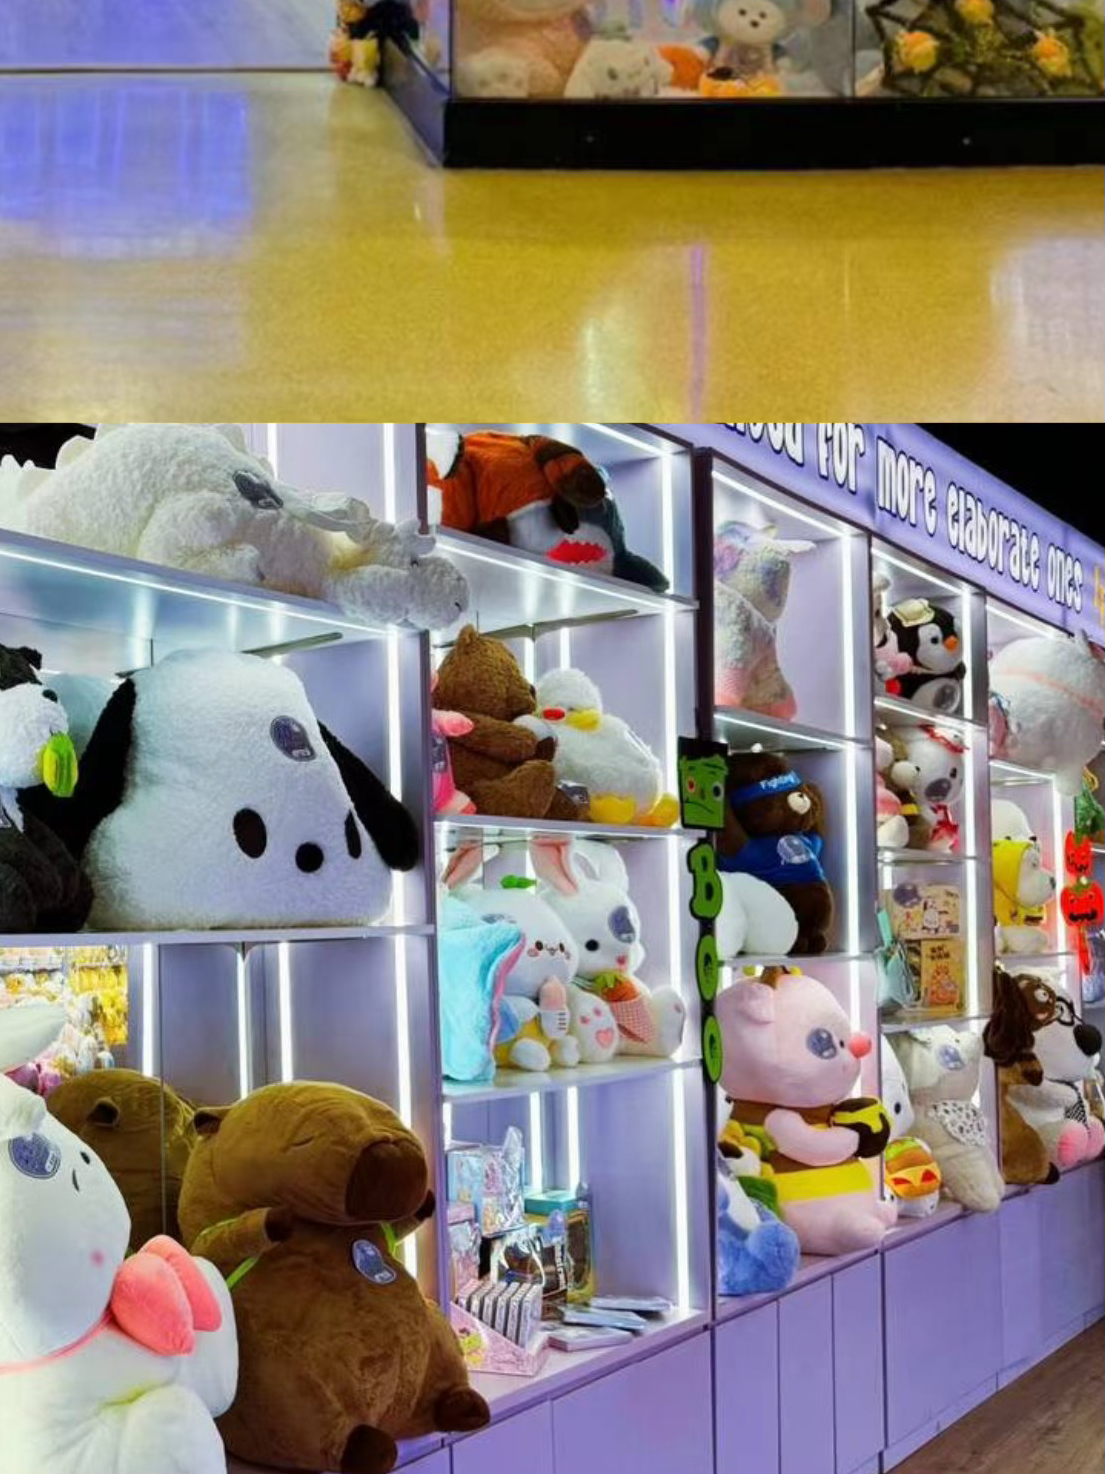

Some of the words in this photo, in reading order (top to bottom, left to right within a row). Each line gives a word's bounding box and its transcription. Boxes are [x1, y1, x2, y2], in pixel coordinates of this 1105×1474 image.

[877, 436, 938, 537] more
[946, 481, 1041, 593] elaborate
[1046, 543, 1083, 614] ones
